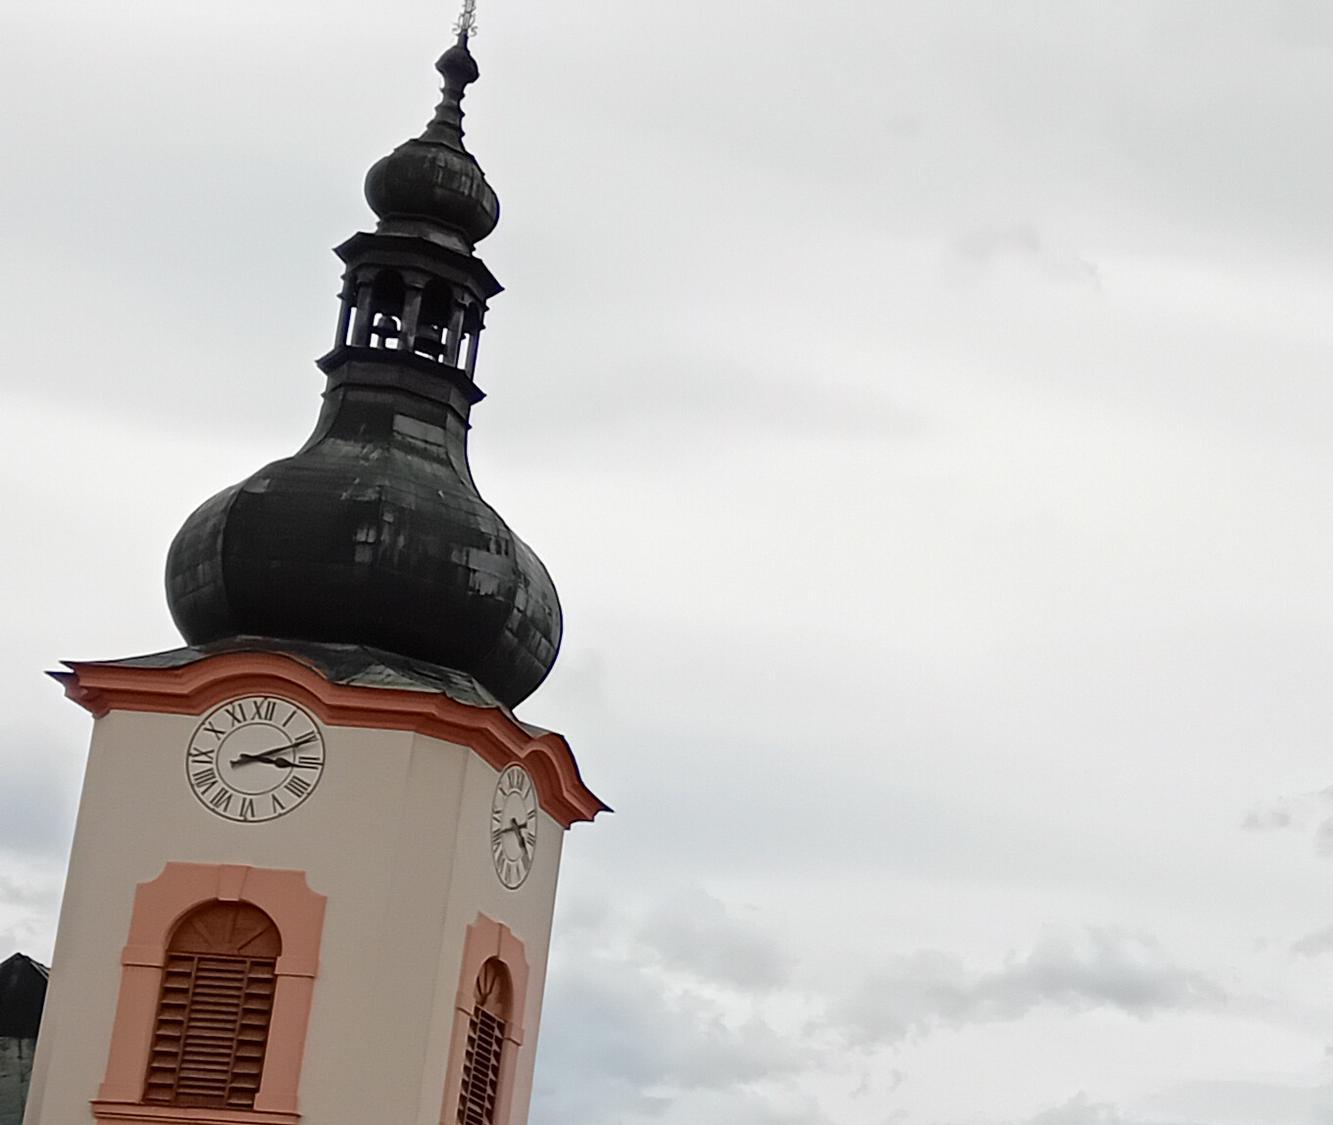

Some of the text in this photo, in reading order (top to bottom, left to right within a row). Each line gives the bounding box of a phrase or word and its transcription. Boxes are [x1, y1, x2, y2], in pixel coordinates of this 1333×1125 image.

[225, 704, 247, 727] XI
[251, 701, 276, 721] XII
[203, 722, 226, 740] X
